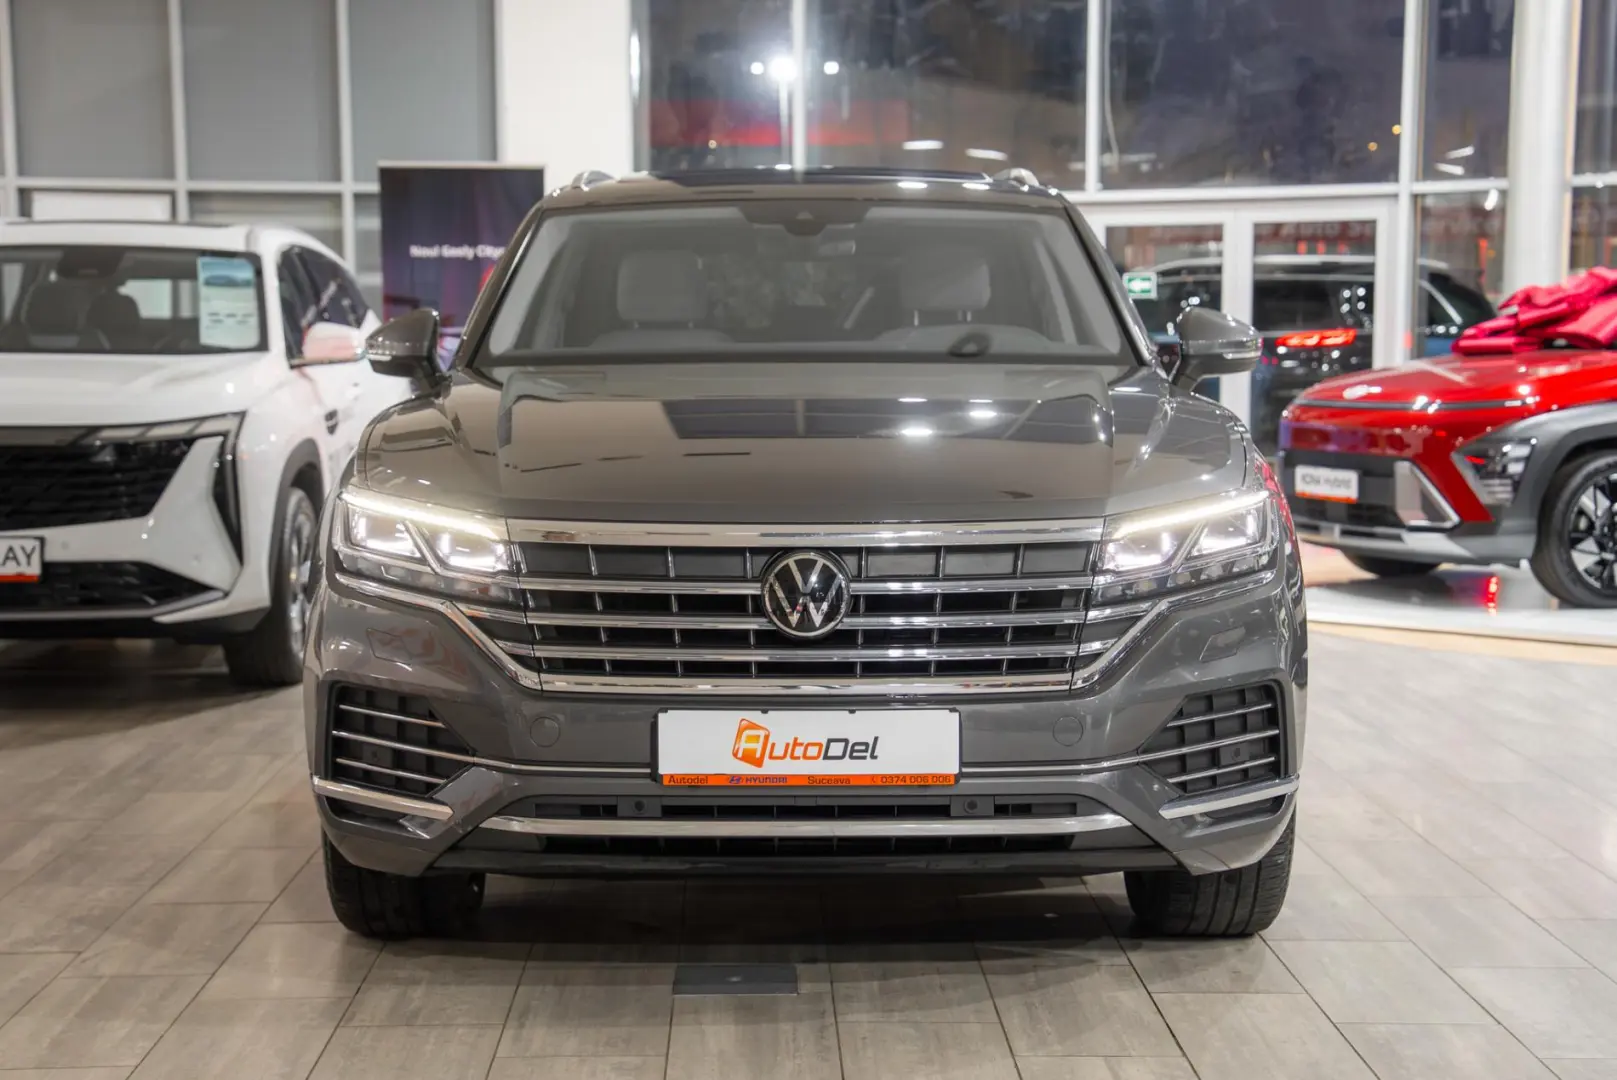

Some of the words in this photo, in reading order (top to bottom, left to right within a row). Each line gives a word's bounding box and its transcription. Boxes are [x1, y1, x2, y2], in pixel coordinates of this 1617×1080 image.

[0, 545, 36, 567] AY
[736, 728, 879, 761] AutoDel
[667, 775, 708, 785] Autodel
[745, 775, 788, 784] HYUNDAI
[807, 775, 851, 785] Suceava
[880, 775, 907, 784] 0374
[909, 775, 929, 784] 006
[931, 775, 951, 784] 006
